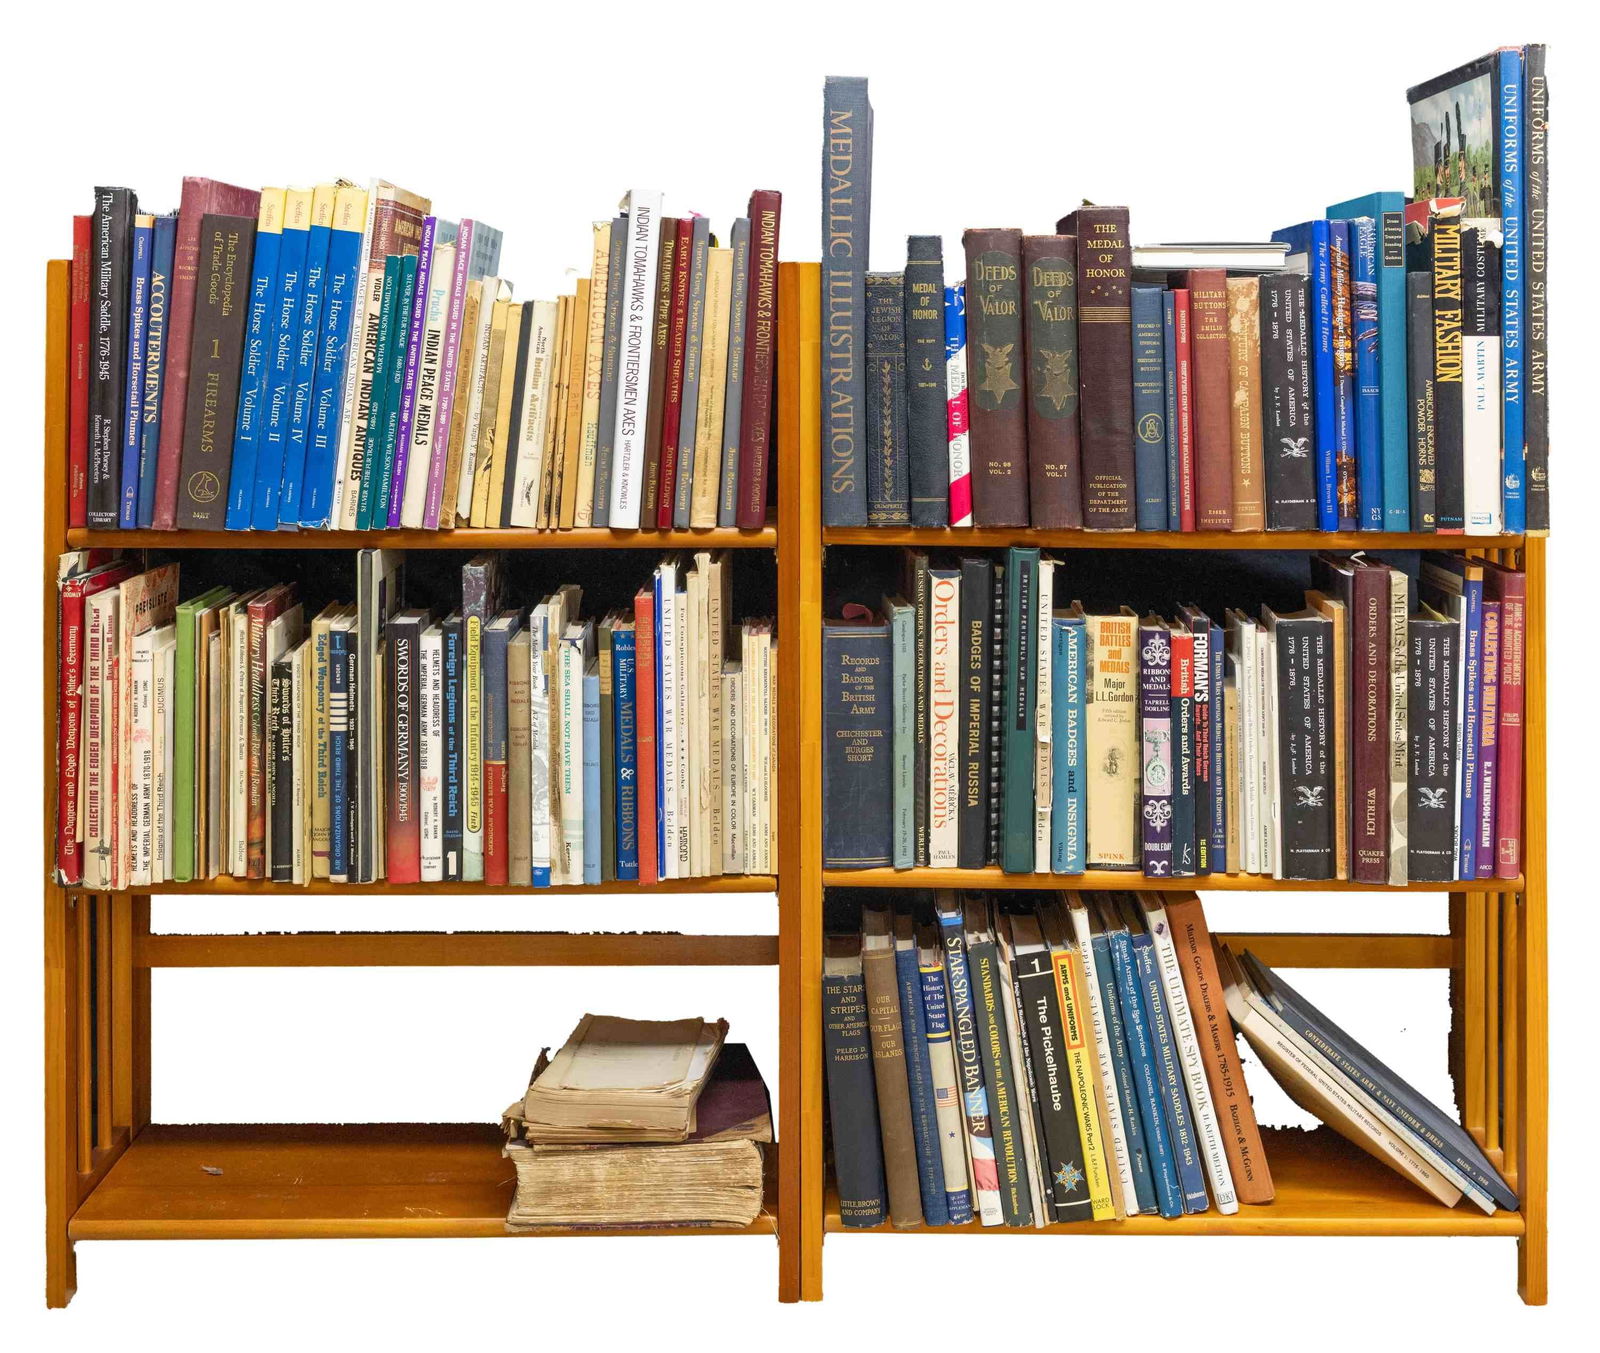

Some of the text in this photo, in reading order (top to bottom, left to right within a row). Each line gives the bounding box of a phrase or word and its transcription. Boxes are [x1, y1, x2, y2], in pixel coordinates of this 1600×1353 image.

[1087, 239, 1124, 248] MEDAL
[1094, 224, 1117, 233] THE
[1504, 84, 1519, 404] UNIFORMS of the UNITED STATES ARMY
[209, 232, 222, 304] of Trade Goods
[221, 233, 238, 316] The Encyclopedia
[1032, 267, 1073, 287] DEEDS
[1087, 268, 1125, 277] HONOR
[1099, 254, 1114, 263] OF
[98, 193, 113, 380] The American Military Saddle, 1776-1945
[256, 277, 268, 297] The
[372, 278, 381, 302] VIDLER
[429, 289, 444, 322] Prucha
[829, 110, 856, 493] MEDALLIC ILLUSTRATIONS
[913, 284, 937, 293] MEDAL
[920, 297, 930, 306] OF
[1048, 290, 1061, 298] OF
[1435, 224, 1462, 382] MILITARY FASHION
[251, 302, 265, 334] Horse
[622, 207, 650, 436] INDIAN TOMAHAWKS & FRONTIERSMEN AXES
[913, 309, 938, 320] HONOR
[1034, 301, 1073, 321] VALOR
[128, 277, 144, 445] Brass Spikes and Horsetail Plumes
[143, 271, 166, 424] ACCOUTERMENTS
[247, 339, 261, 375] Soldier
[350, 313, 379, 481] AMERICAN INDIAN ANTIQUES
[414, 329, 440, 445] INDIAN PEACE MEDALS
[201, 373, 219, 452] FIREARMS
[242, 389, 257, 431] Volume
[1418, 399, 1426, 431] POWDER
[1426, 380, 1435, 465] AMERICAN ENGRAVED
[101, 427, 111, 449] Stephen
[623, 440, 631, 470] HARTZLER
[101, 452, 109, 471] Dorsey
[348, 490, 357, 517] BARNES
[620, 479, 628, 509] KNOWLES
[251, 615, 264, 659] Military
[619, 659, 627, 698] MILITARY
[841, 655, 880, 665] RECORDS
[842, 674, 874, 683] BADGES
[1368, 598, 1377, 741] ORDERS AND DECORATIONS
[1482, 612, 1497, 746] COLLECTING MILITARIA
[157, 678, 165, 713] DUCIMUS
[251, 660, 264, 711] Headdress
[841, 692, 875, 702] BRITISH
[934, 580, 955, 828] Orders and Decorations
[251, 713, 260, 740] Colonel
[851, 704, 875, 714] ARMY
[968, 620, 982, 806] BADGES OF IMPERIAL RUSSIA
[1179, 658, 1190, 794] British Orders and Awards
[396, 638, 409, 822] SWORDS OF GERMANY 1900/1945
[1067, 628, 1078, 862] AMERICAN BADGES and INSIGNIA
[620, 701, 634, 850] MEDALS & RIBBONS
[1367, 788, 1376, 835] WERLICH
[1142, 946, 1152, 974] Steffen
[923, 984, 944, 992] History
[1060, 964, 1079, 1041] ARMS and UNIFORMS
[932, 1021, 944, 1029] Flag
[1161, 943, 1208, 1111] THE ULTIMATE SPY BOOK
[1185, 924, 1196, 954] MILITARY
[1193, 956, 1205, 981] GOODS
[1199, 983, 1211, 1012] DEALERS
[1209, 1024, 1221, 1051] MAKERS
[1216, 1054, 1235, 1097] 1785-1915
[946, 936, 986, 1132] STAR-SPANGLED BANNER
[1036, 996, 1062, 1111] The Pickelhaube
[1150, 980, 1192, 1165] UNITED STATES MILITARY SADDLES 1812-1943
